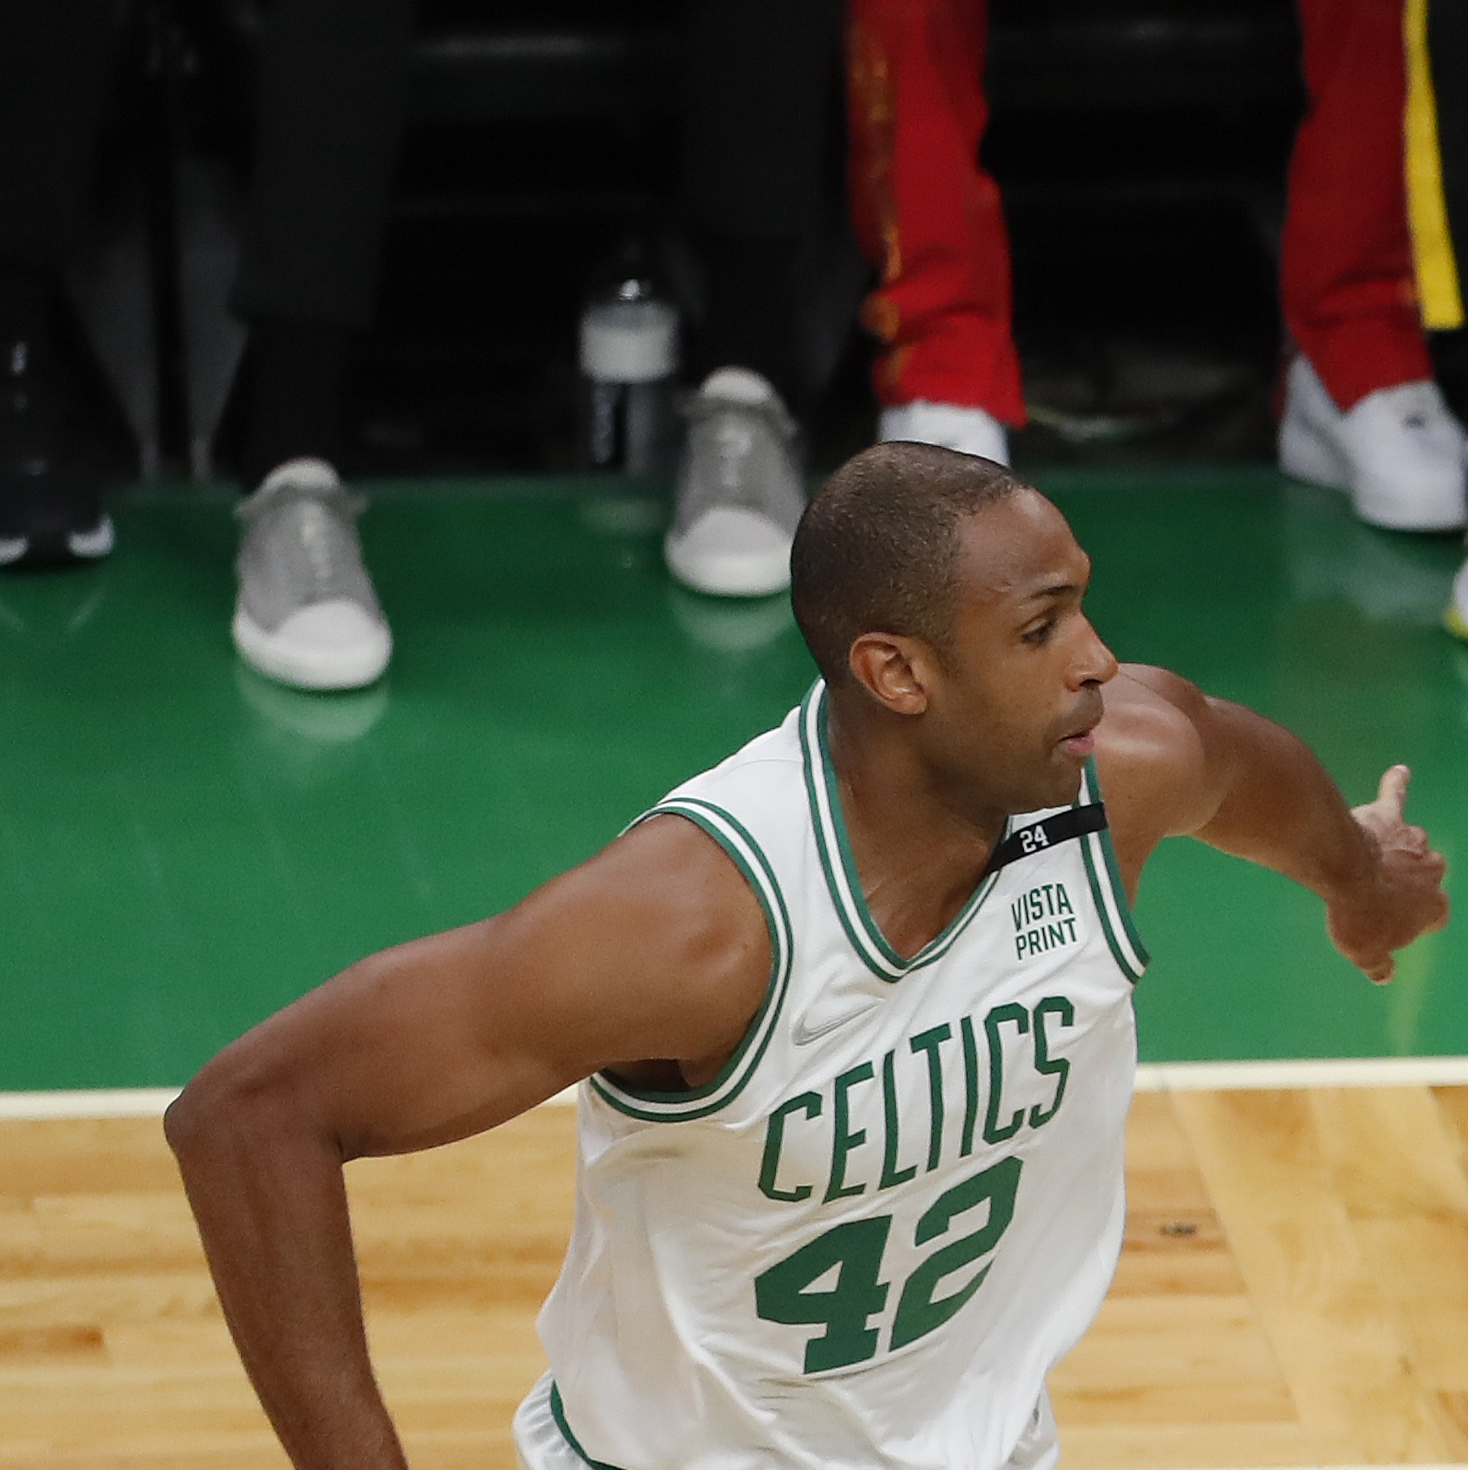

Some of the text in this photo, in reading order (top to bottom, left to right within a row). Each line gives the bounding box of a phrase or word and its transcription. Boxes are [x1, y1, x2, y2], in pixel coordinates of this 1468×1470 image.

[1019, 824, 1049, 853] 24
[1010, 883, 1074, 932] VISTA
[1015, 917, 1077, 961] PRINT
[758, 996, 1074, 1205] CELTICS
[754, 1156, 1023, 1375] 42
